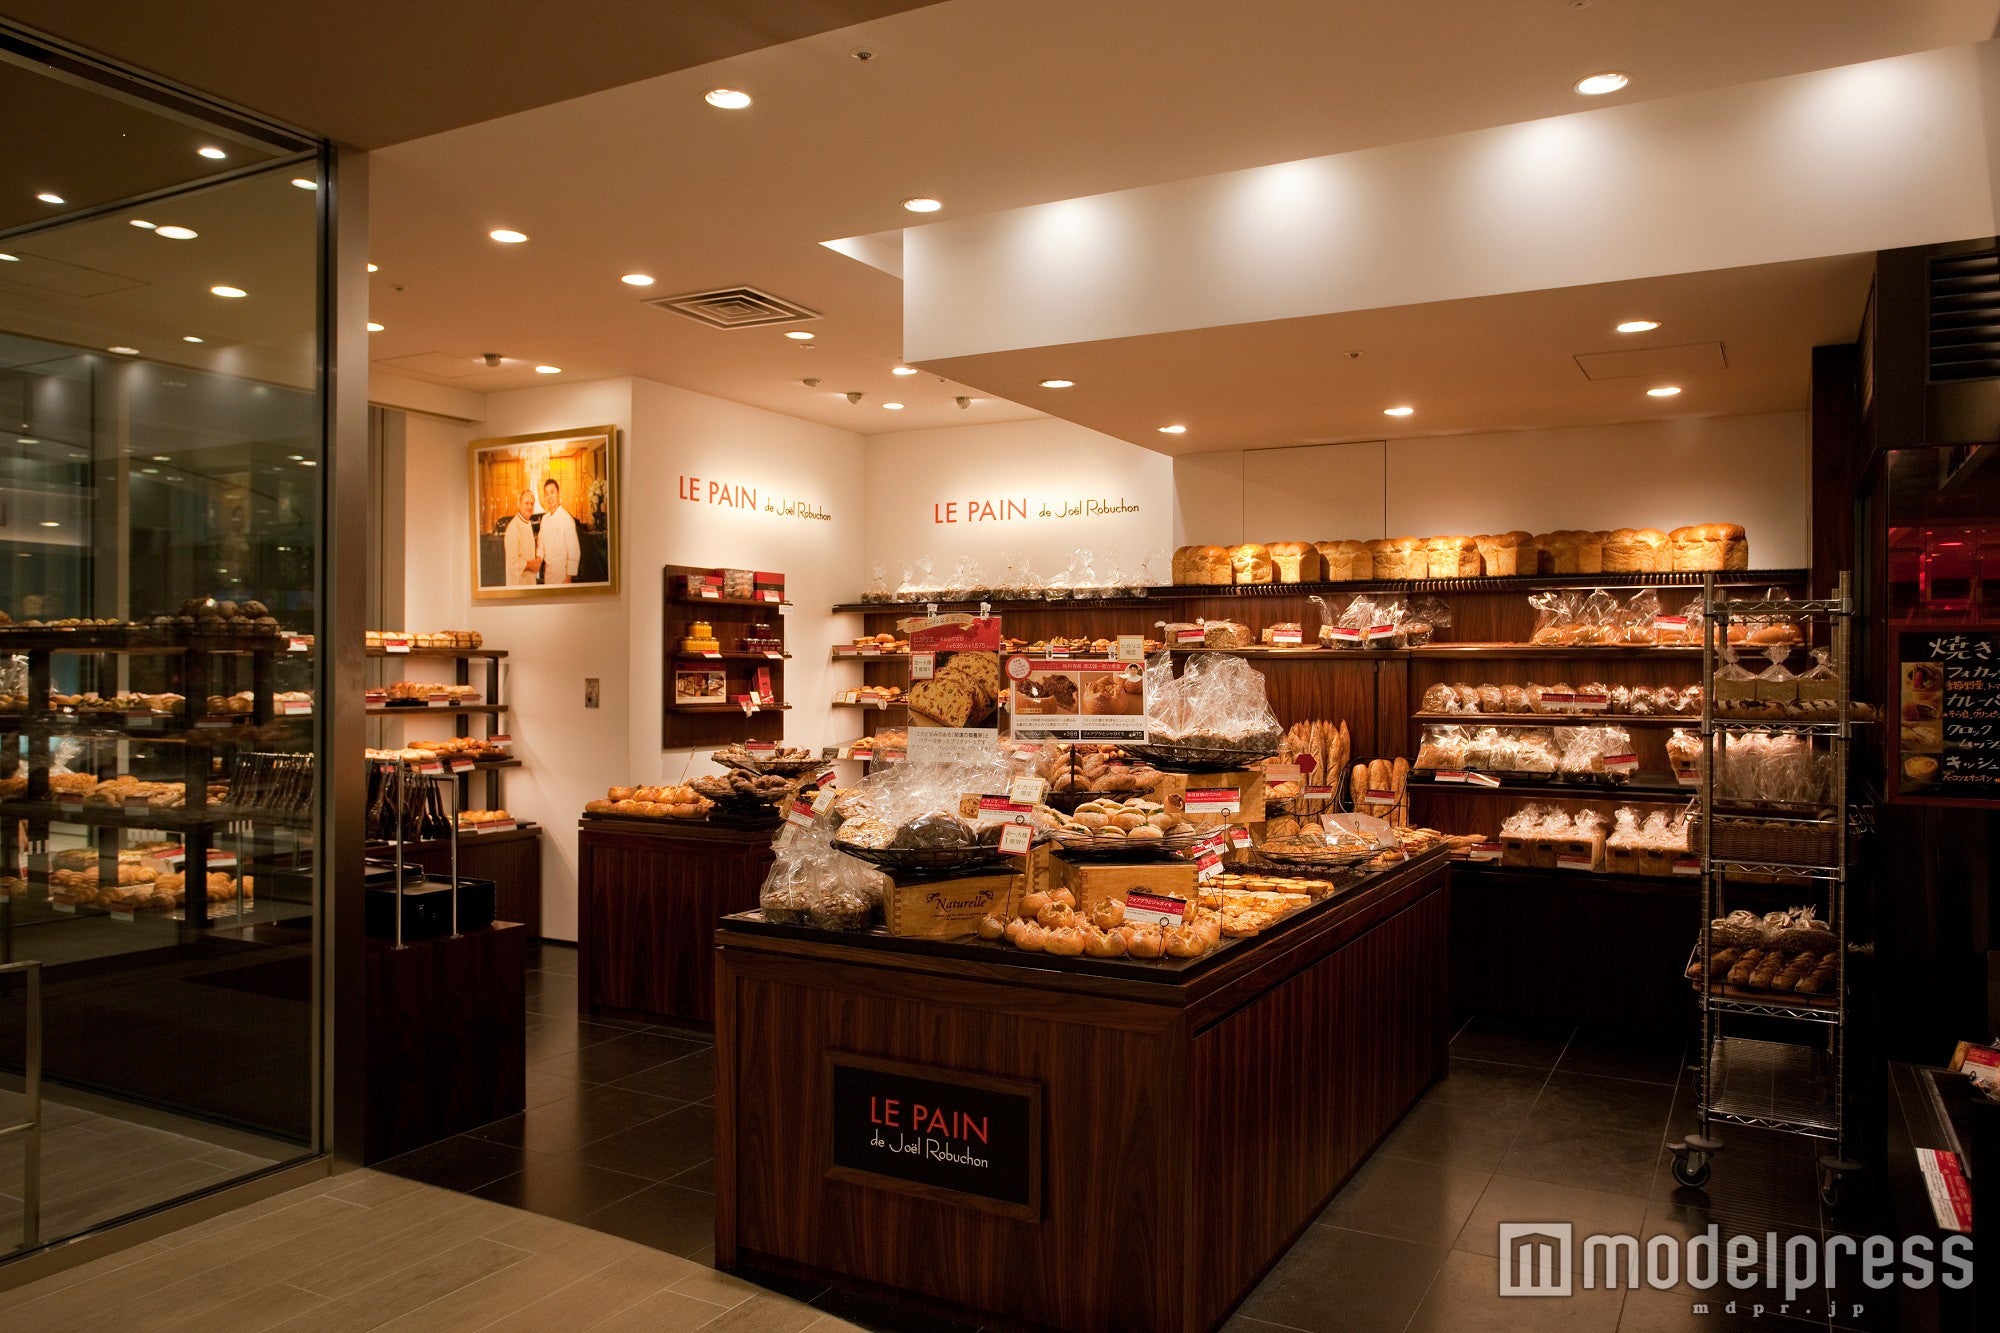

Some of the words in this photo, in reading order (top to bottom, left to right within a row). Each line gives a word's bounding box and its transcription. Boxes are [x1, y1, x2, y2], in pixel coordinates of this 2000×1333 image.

[679, 475, 701, 502] LE
[708, 480, 757, 511] PAIN
[764, 497, 775, 513] de
[797, 501, 832, 521] Robuchon
[934, 502, 958, 524] LE
[968, 498, 1027, 522] PAIN
[1039, 502, 1052, 518] de
[1054, 500, 1082, 518] Joël
[1086, 498, 1140, 516] Robuchon
[1928, 634, 2000, 662] 焼き
[1945, 723, 1993, 737] クロック
[935, 896, 986, 912] Naturelle
[870, 1096, 900, 1128] LE
[913, 1103, 988, 1145] PAIN
[870, 1129, 885, 1148] de
[888, 1133, 921, 1154] Joël
[926, 1138, 988, 1168] Robuchon
